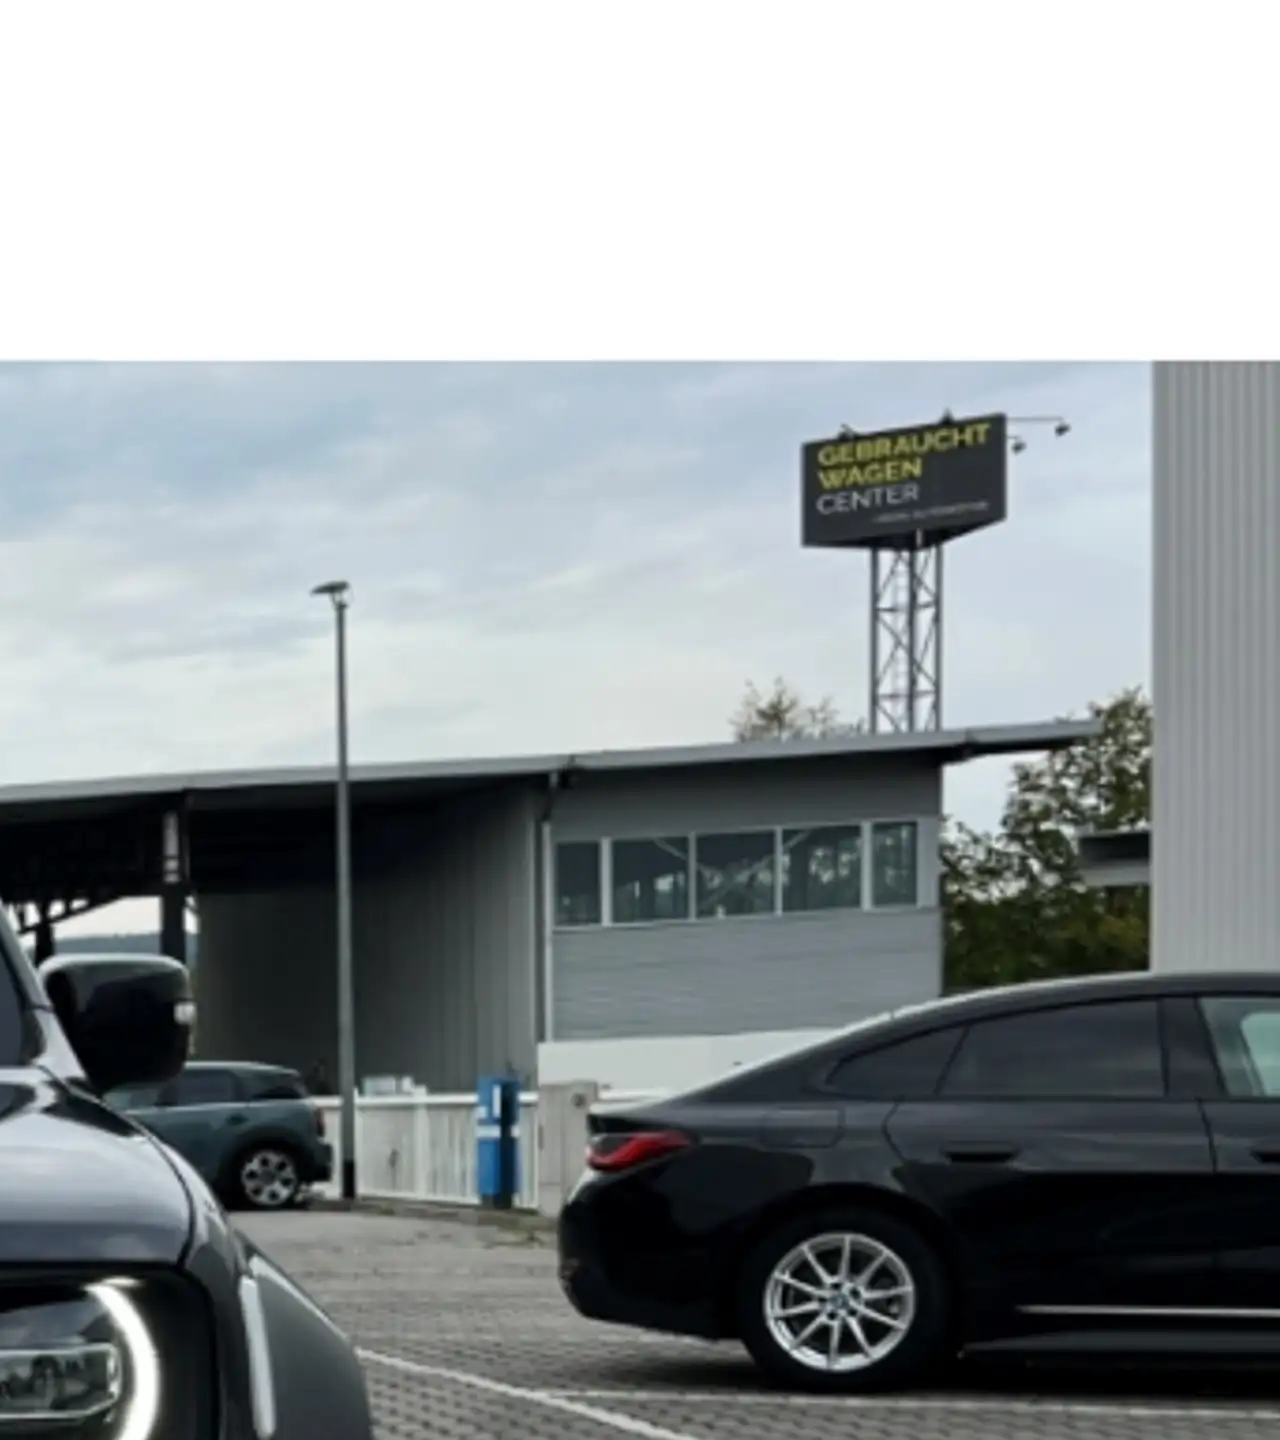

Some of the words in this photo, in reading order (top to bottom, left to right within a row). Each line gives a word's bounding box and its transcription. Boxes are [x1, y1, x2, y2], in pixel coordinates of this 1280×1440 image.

[817, 422, 991, 467] GEBRAUCHT
[817, 457, 923, 490] WAGEN
[816, 482, 920, 516] CENTER
